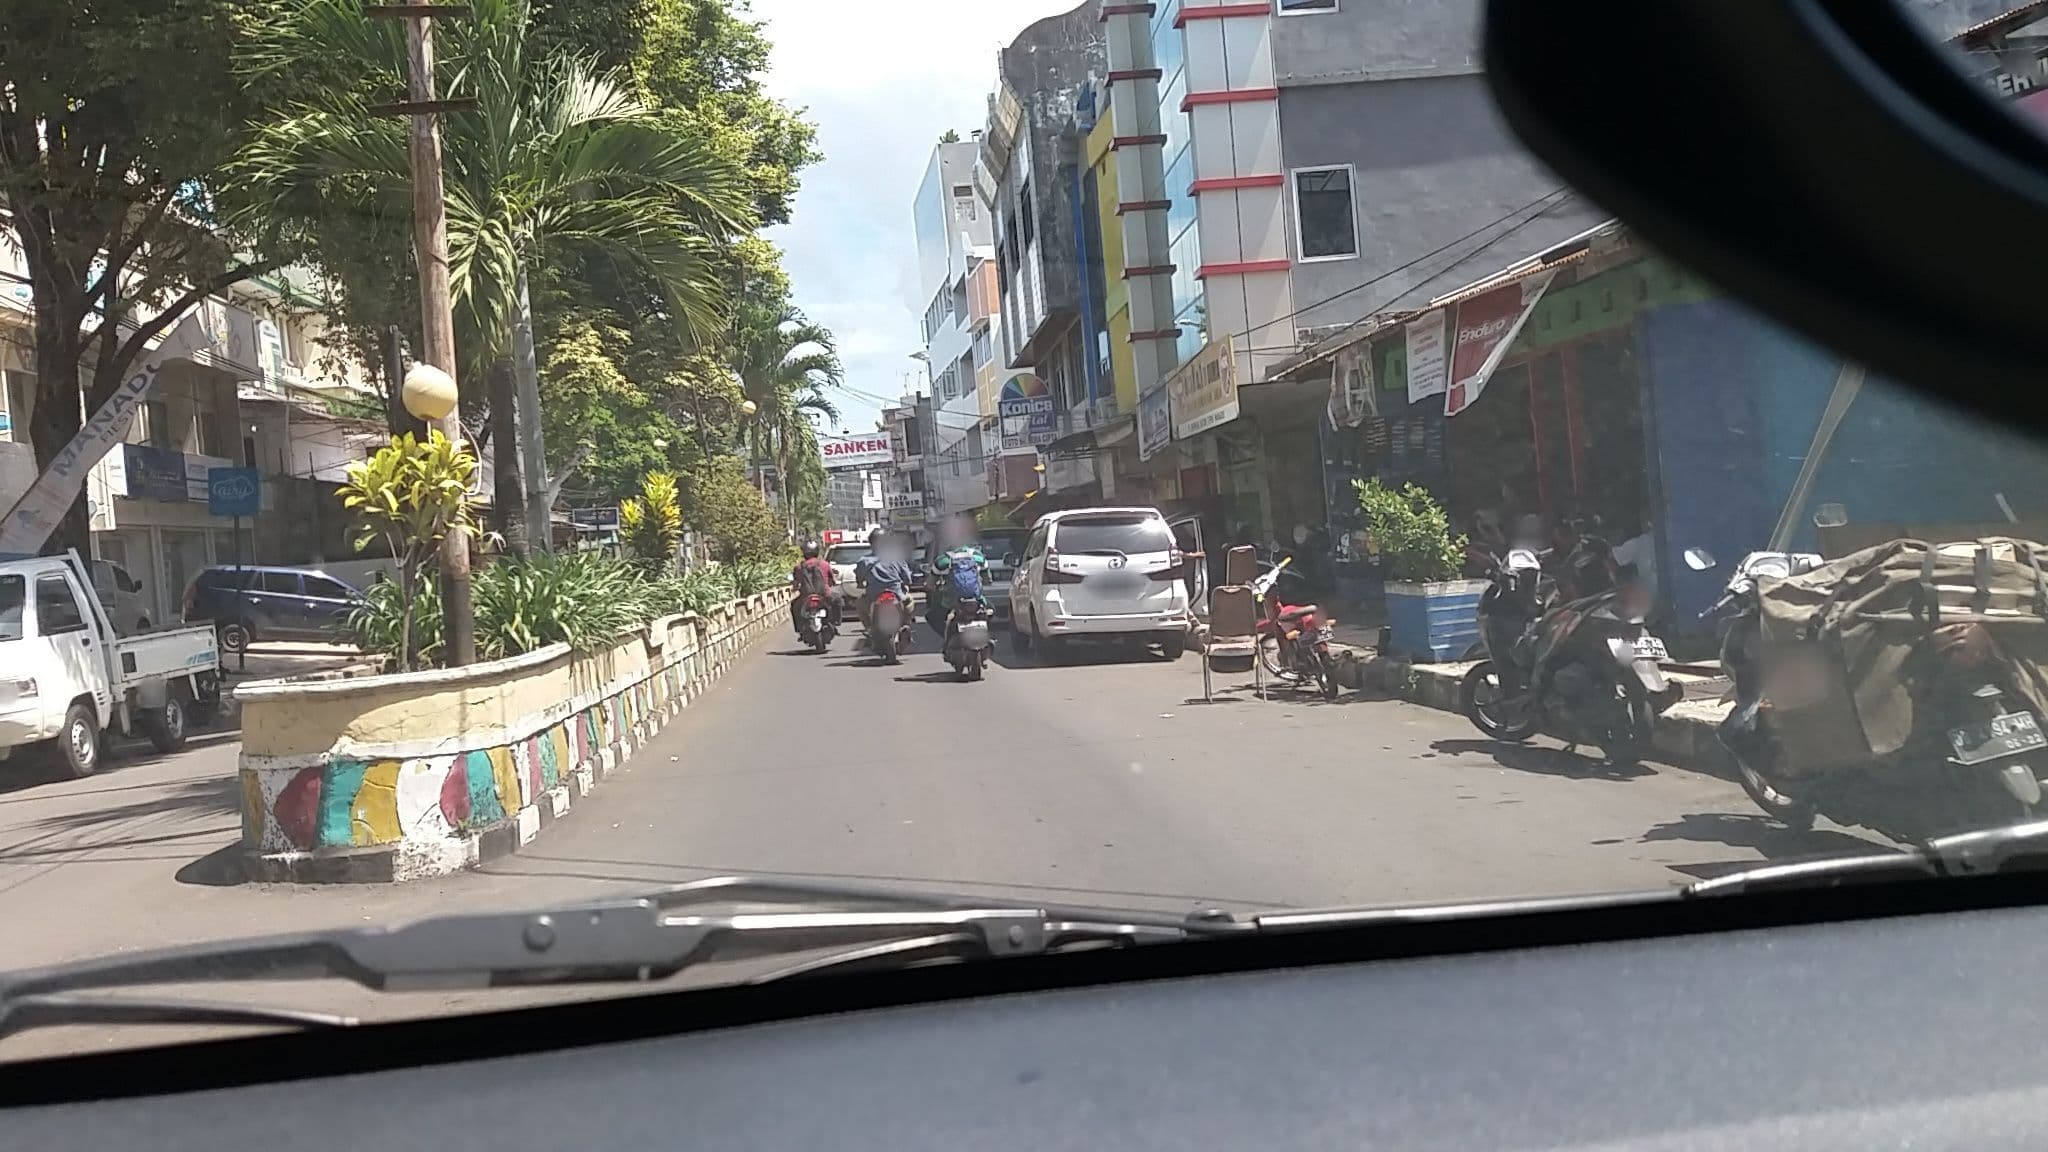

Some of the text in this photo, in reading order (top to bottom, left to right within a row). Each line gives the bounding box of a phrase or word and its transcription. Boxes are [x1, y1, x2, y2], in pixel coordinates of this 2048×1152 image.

[1458, 318, 1506, 343] Enduro
[1001, 399, 1053, 417] Konica
[823, 439, 888, 455] SANKEN
